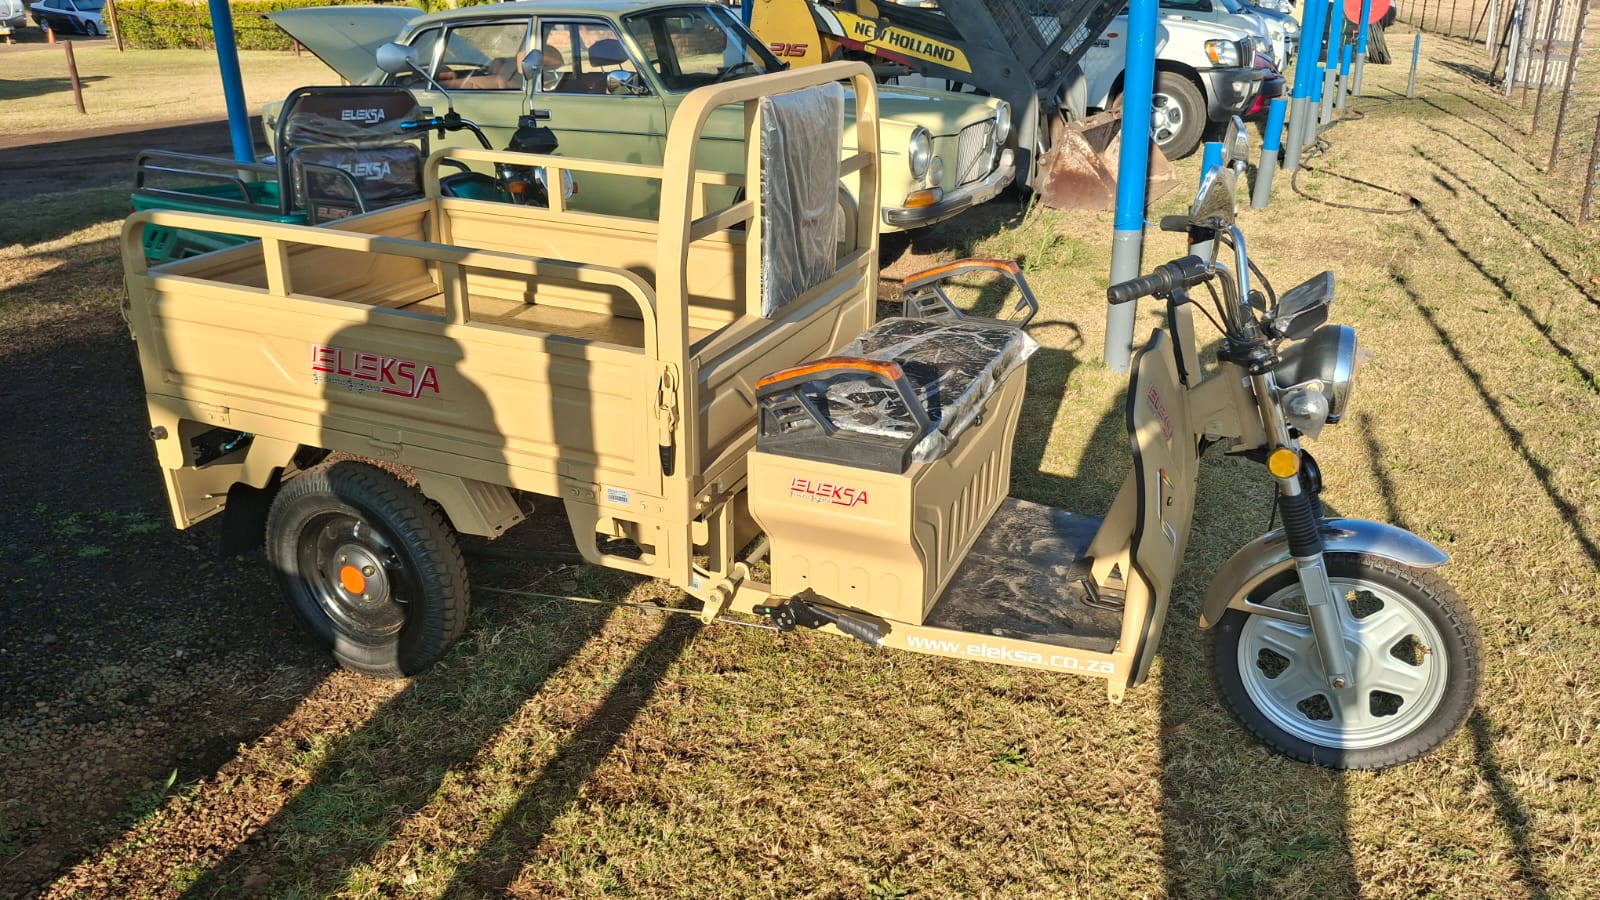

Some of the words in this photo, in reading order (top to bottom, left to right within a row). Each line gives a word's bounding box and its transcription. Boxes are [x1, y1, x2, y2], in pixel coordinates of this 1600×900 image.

[854, 21, 887, 41] NEW
[888, 31, 956, 63] HOLLAND
[341, 108, 385, 124] ELEKSA
[311, 344, 440, 399] ELEKSA
[790, 477, 868, 507] ELEKSA
[906, 635, 1115, 674] www.eleksa.co.za
